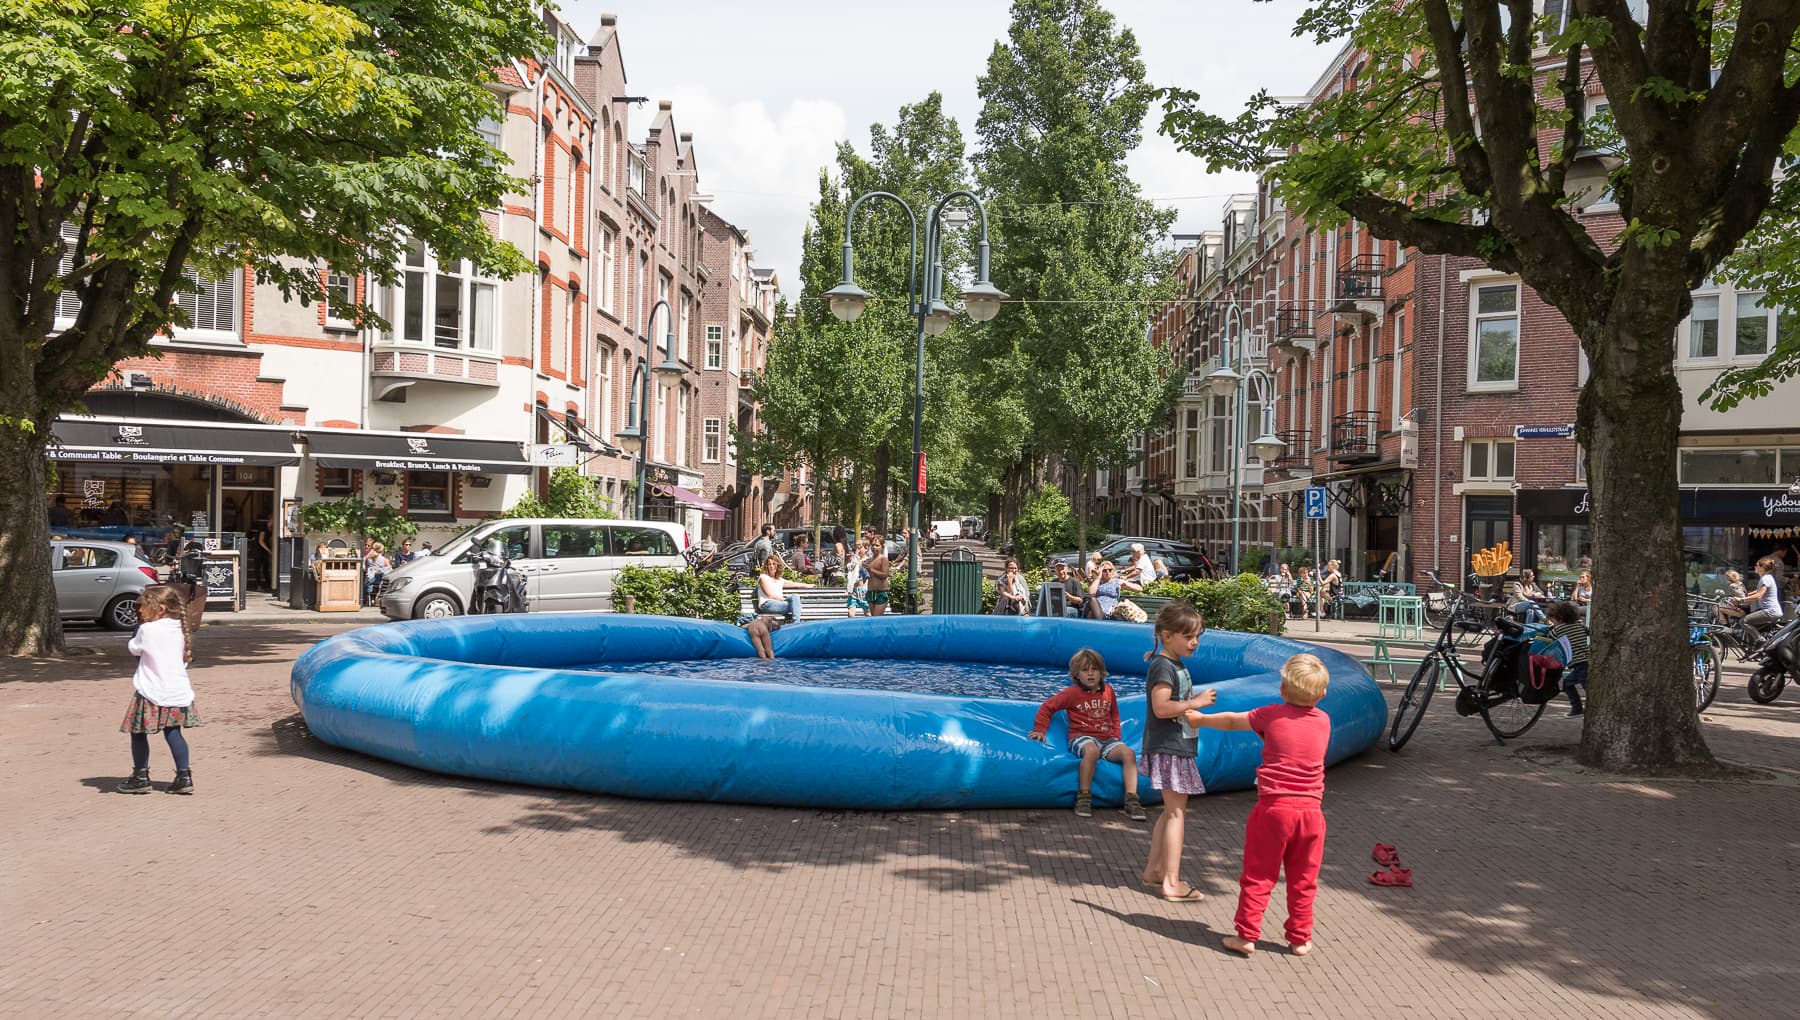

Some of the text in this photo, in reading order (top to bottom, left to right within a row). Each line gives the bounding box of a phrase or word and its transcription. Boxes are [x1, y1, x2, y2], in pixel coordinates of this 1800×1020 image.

[58, 451, 100, 459] Communal
[101, 452, 122, 460] Table
[132, 452, 178, 463] Boulangerie
[188, 454, 208, 462] Table
[208, 455, 244, 463] Commune
[375, 461, 406, 469] Breakfast,
[407, 462, 431, 470] Brunch,
[458, 464, 481, 472] Pastries
[1309, 490, 1320, 505] P
